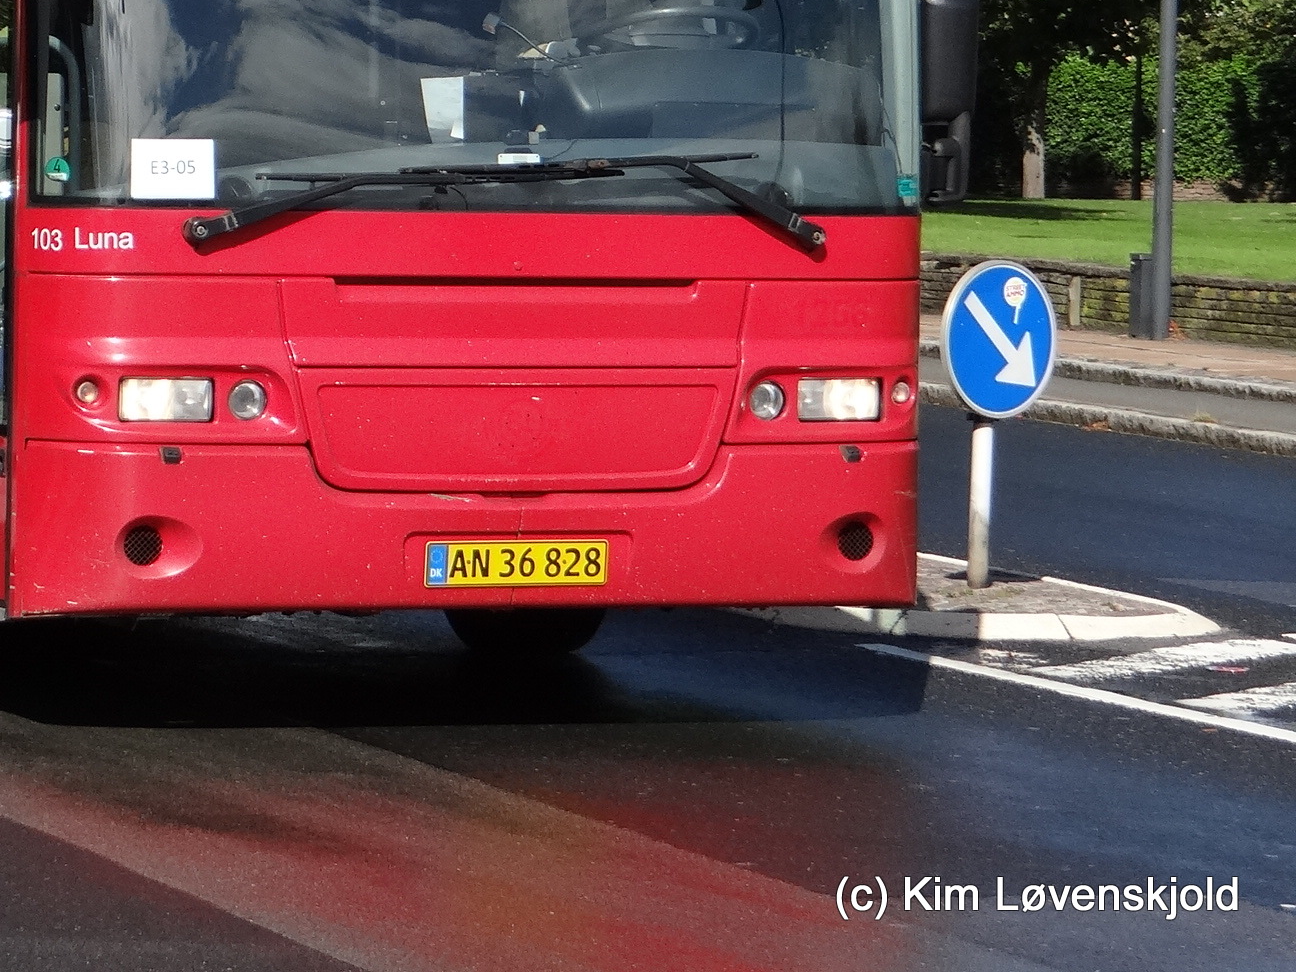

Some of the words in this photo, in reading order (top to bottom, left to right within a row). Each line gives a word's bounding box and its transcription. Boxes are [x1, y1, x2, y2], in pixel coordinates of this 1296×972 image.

[150, 159, 196, 175] E3-05
[31, 227, 63, 251] 103
[74, 227, 134, 250] Luna
[429, 568, 443, 578] DK
[449, 549, 490, 578] AN
[499, 547, 535, 578] 36
[544, 546, 601, 578] 828
